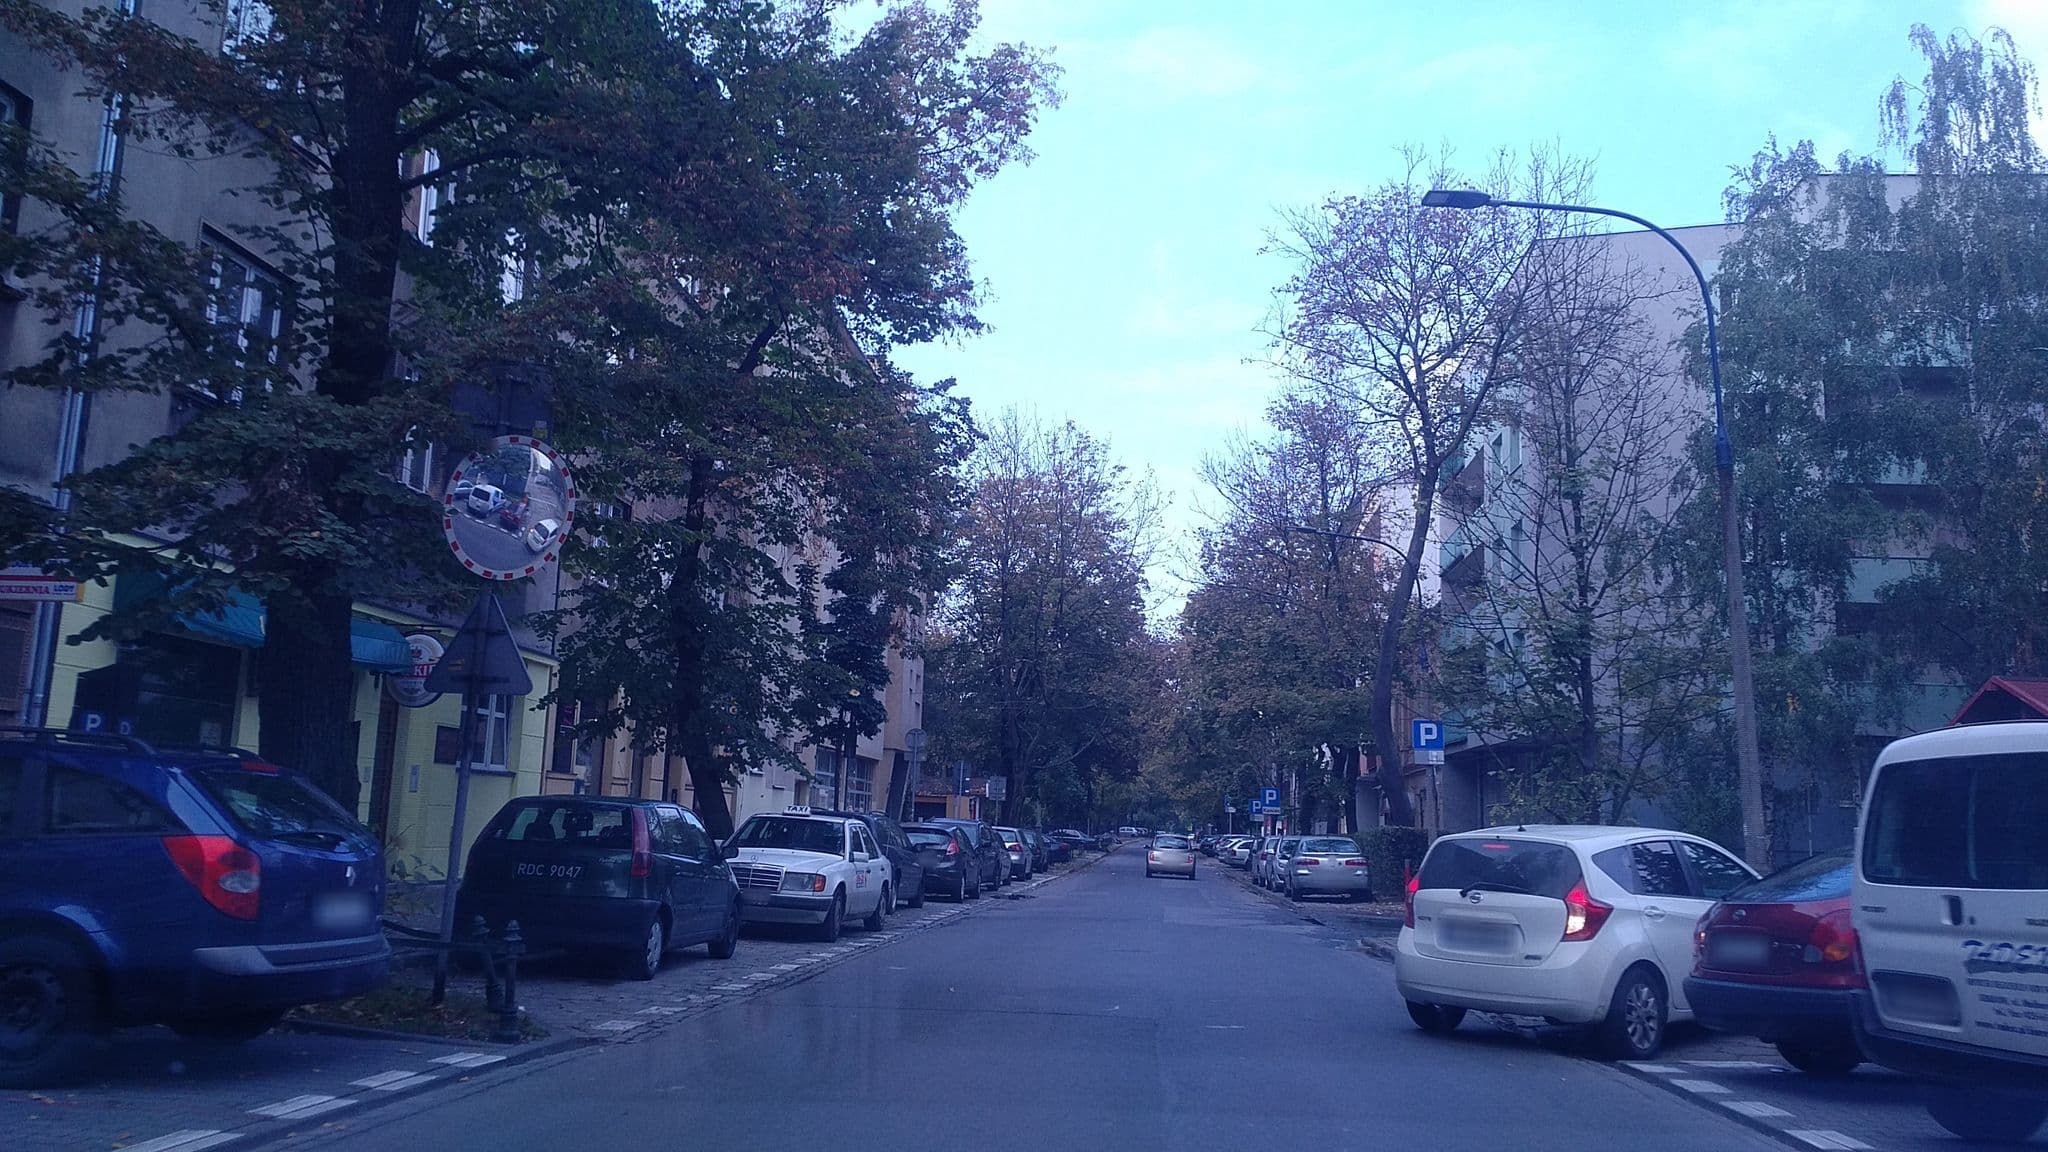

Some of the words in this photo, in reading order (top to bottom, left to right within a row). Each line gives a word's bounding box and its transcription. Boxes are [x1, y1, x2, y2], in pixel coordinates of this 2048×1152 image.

[1420, 723, 1437, 746] P
[1265, 790, 1276, 804] P
[787, 805, 809, 813] TAXI
[1252, 801, 1261, 813] P
[517, 863, 545, 876] RDC
[550, 864, 584, 878] 9047
